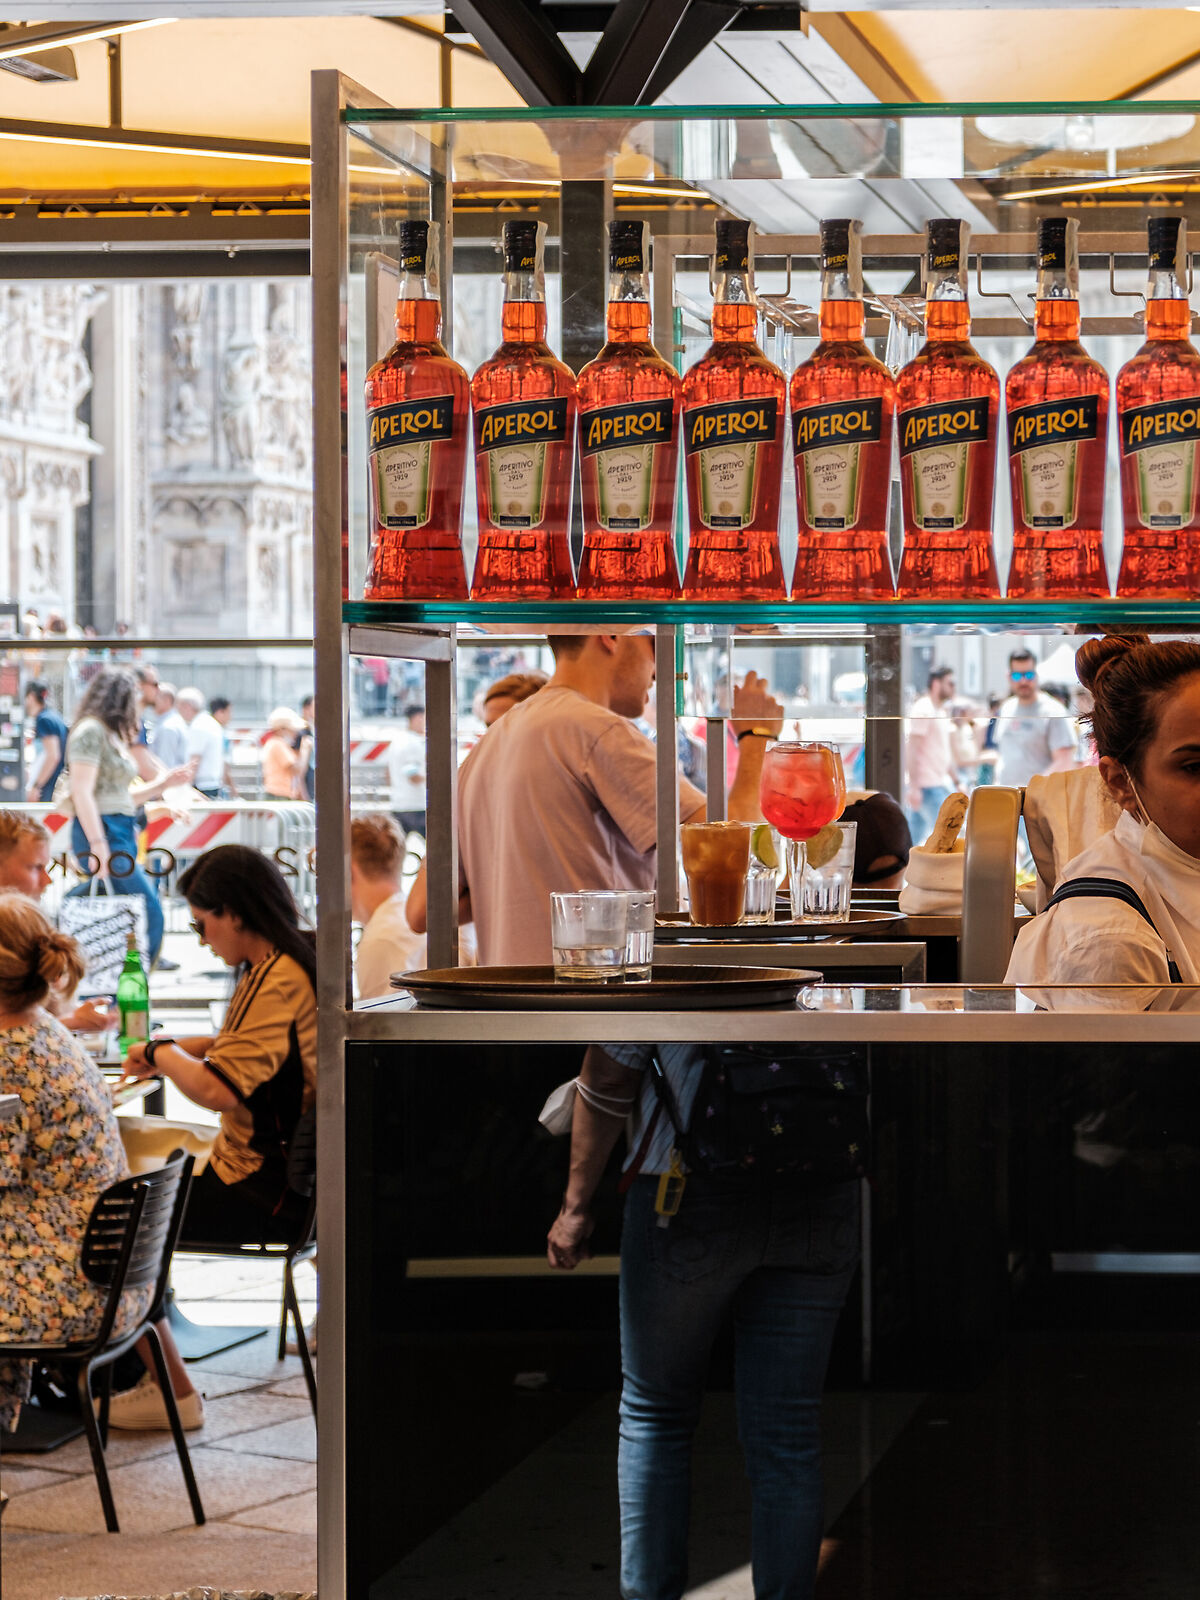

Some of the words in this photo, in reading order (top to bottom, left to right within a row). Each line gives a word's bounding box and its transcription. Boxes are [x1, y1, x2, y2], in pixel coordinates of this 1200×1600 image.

[616, 255, 641, 267] APEROL
[934, 253, 958, 266] APEROL
[370, 409, 443, 446] APEROL
[481, 411, 558, 446] APEROL
[588, 411, 665, 447] APEROL
[692, 410, 768, 444] APEROL
[797, 411, 872, 446] APEROL
[904, 409, 980, 447] APEROL
[1013, 408, 1089, 446] APEROL
[386, 459, 418, 473] APERITIVO
[499, 460, 533, 473] APERITIVO
[607, 462, 641, 474] APERITIVO
[710, 460, 744, 473] APERITIVO
[814, 461, 847, 474] APERITIVO
[922, 461, 956, 474] APERITIVO
[1031, 460, 1065, 473] APERITIVO
[1148, 459, 1183, 472] APERITIVO
[394, 473, 408, 482] 1919
[508, 473, 524, 482] 1919
[617, 476, 632, 484] 1919
[719, 474, 735, 482] 1919
[822, 475, 837, 483] 1919
